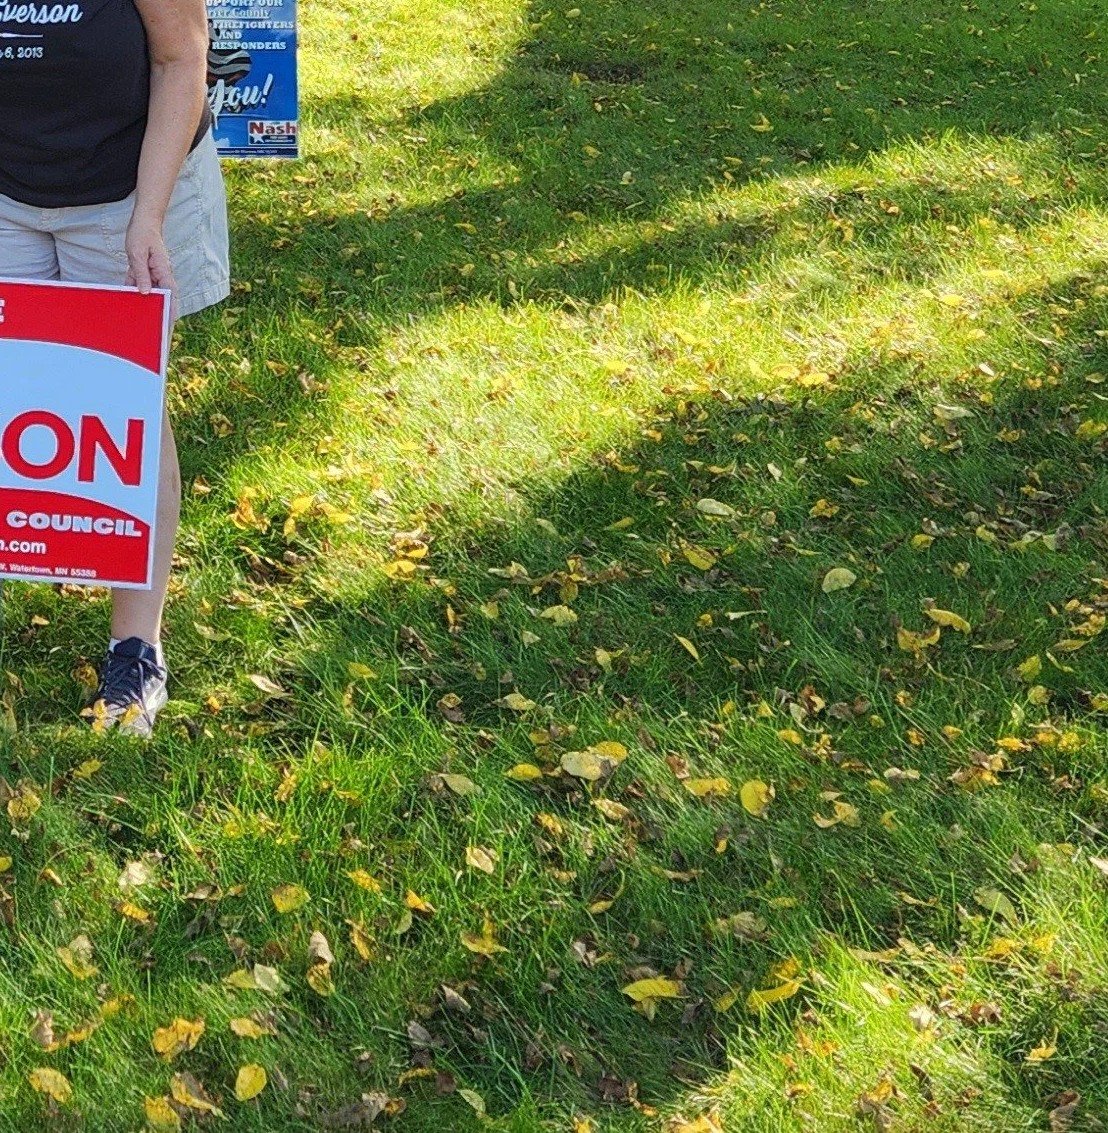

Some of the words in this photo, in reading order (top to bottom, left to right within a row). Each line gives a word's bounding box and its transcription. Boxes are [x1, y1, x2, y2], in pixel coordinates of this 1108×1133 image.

[213, 20, 294, 29] FIREFIGHTERS
[219, 29, 242, 39] AND
[212, 41, 286, 50] RESPONDERS
[4, 46, 15, 60] 6,
[17, 47, 44, 59] 2013
[249, 122, 296, 134] Nash
[6, 510, 142, 537] COUNCIL
[55, 567, 68, 576] MN
